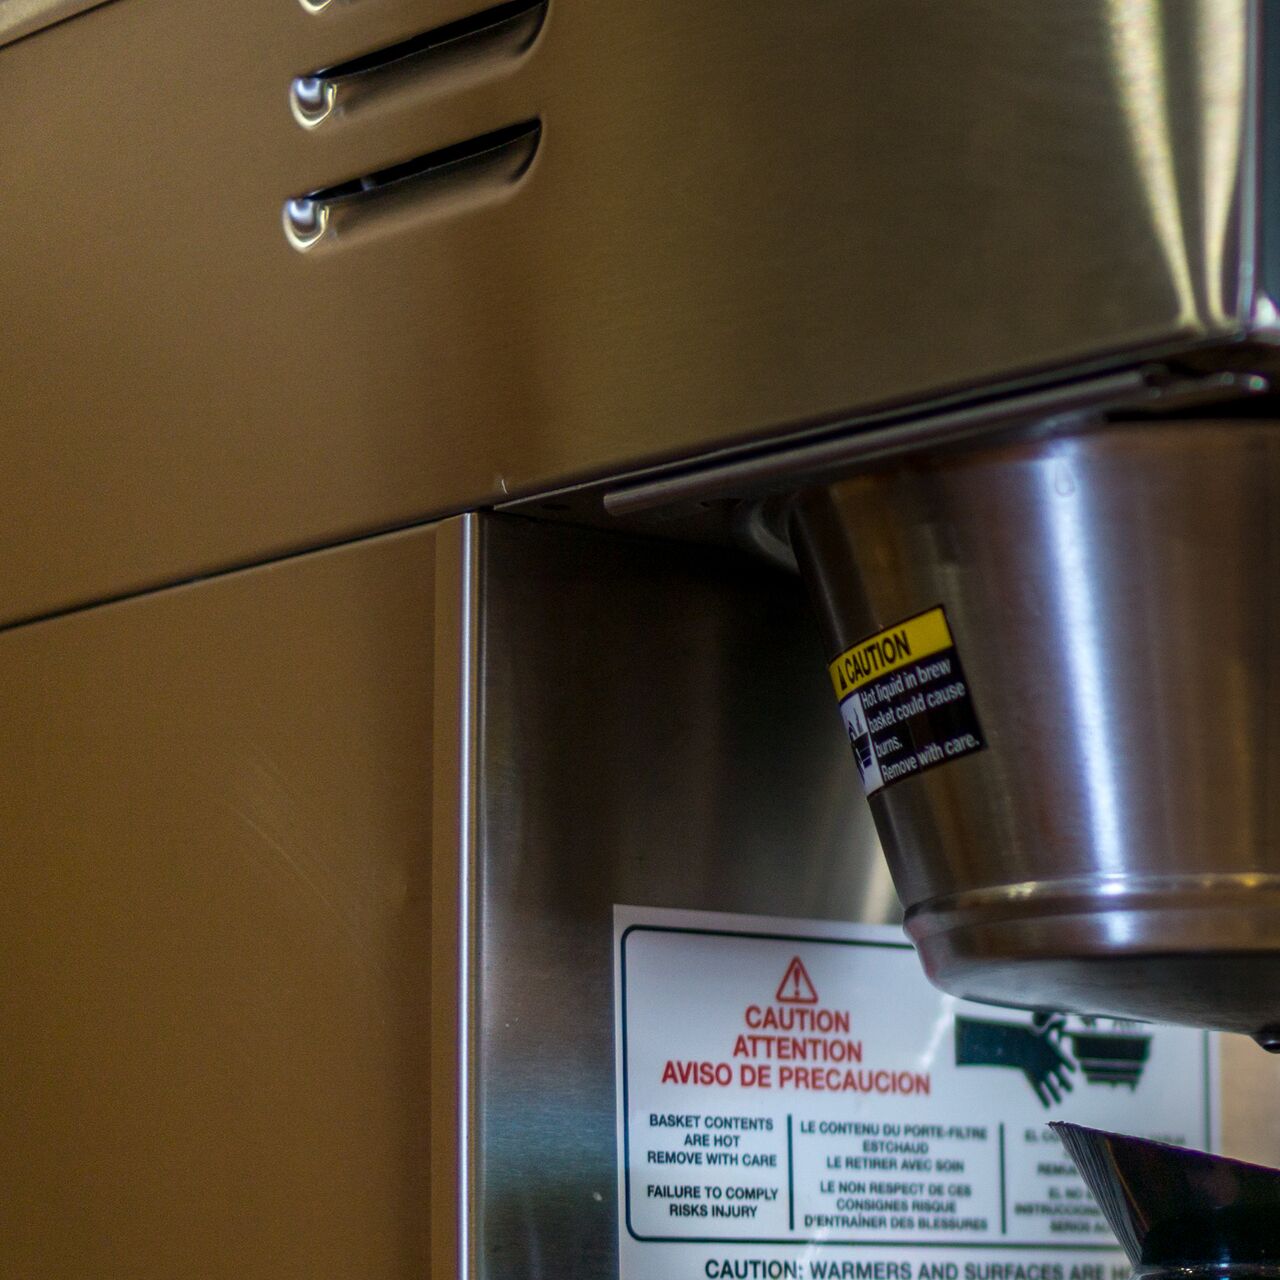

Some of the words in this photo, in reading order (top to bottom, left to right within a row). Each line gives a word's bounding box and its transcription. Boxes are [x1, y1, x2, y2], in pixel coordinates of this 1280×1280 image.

[844, 629, 912, 685] CAUTION
[861, 689, 878, 709] Hot
[875, 675, 905, 702] liquid
[903, 671, 918, 690] in
[916, 659, 951, 684] brew
[867, 708, 897, 734] basket
[896, 693, 926, 721] could
[926, 681, 966, 709] cause
[874, 736, 903, 758] burns.
[881, 756, 918, 783] Remove
[917, 742, 945, 766] with
[944, 733, 980, 755] care.
[745, 1004, 850, 1033] CAUTION
[733, 1034, 862, 1063] ATTENTION
[662, 1060, 733, 1087] AVISO
[740, 1064, 772, 1089] DE
[778, 1068, 931, 1095] PRECAUCION
[650, 1113, 702, 1129] BASKET
[704, 1115, 774, 1131] CONTENTS
[800, 1121, 817, 1134] LE
[819, 1121, 880, 1136] CONTENU
[883, 1123, 901, 1136] DU
[903, 1124, 988, 1141] PORTE-FILTRE
[684, 1133, 710, 1147] ARE
[713, 1134, 741, 1148] HOT
[647, 1150, 702, 1165] REMOVE
[706, 1152, 739, 1166] WITH
[742, 1153, 777, 1167] CARE
[826, 1156, 842, 1169] LE
[845, 1157, 897, 1170] RETIRER
[900, 1158, 933, 1172] AVEC
[935, 1159, 965, 1173] SOIN
[647, 1184, 702, 1199] FAILURE
[704, 1186, 722, 1200] TO
[725, 1187, 779, 1201] COMPLY
[820, 1180, 835, 1194] LE
[838, 1181, 866, 1195] NON
[869, 1183, 926, 1196] RESPECT
[928, 1184, 945, 1197] DE
[947, 1185, 972, 1198] CES
[669, 1203, 708, 1217] RISKS
[711, 1205, 758, 1218] INJURY
[836, 1199, 909, 1213] CONSIGNES
[911, 1200, 957, 1214] RISQUE
[804, 1213, 887, 1229] D'ENTRAÎNER
[890, 1216, 915, 1230] DES
[917, 1217, 988, 1232] BLESSURES
[704, 1259, 804, 1280] CAUTION:
[809, 1261, 912, 1280] WARMERS
[918, 1263, 959, 1280] AND
